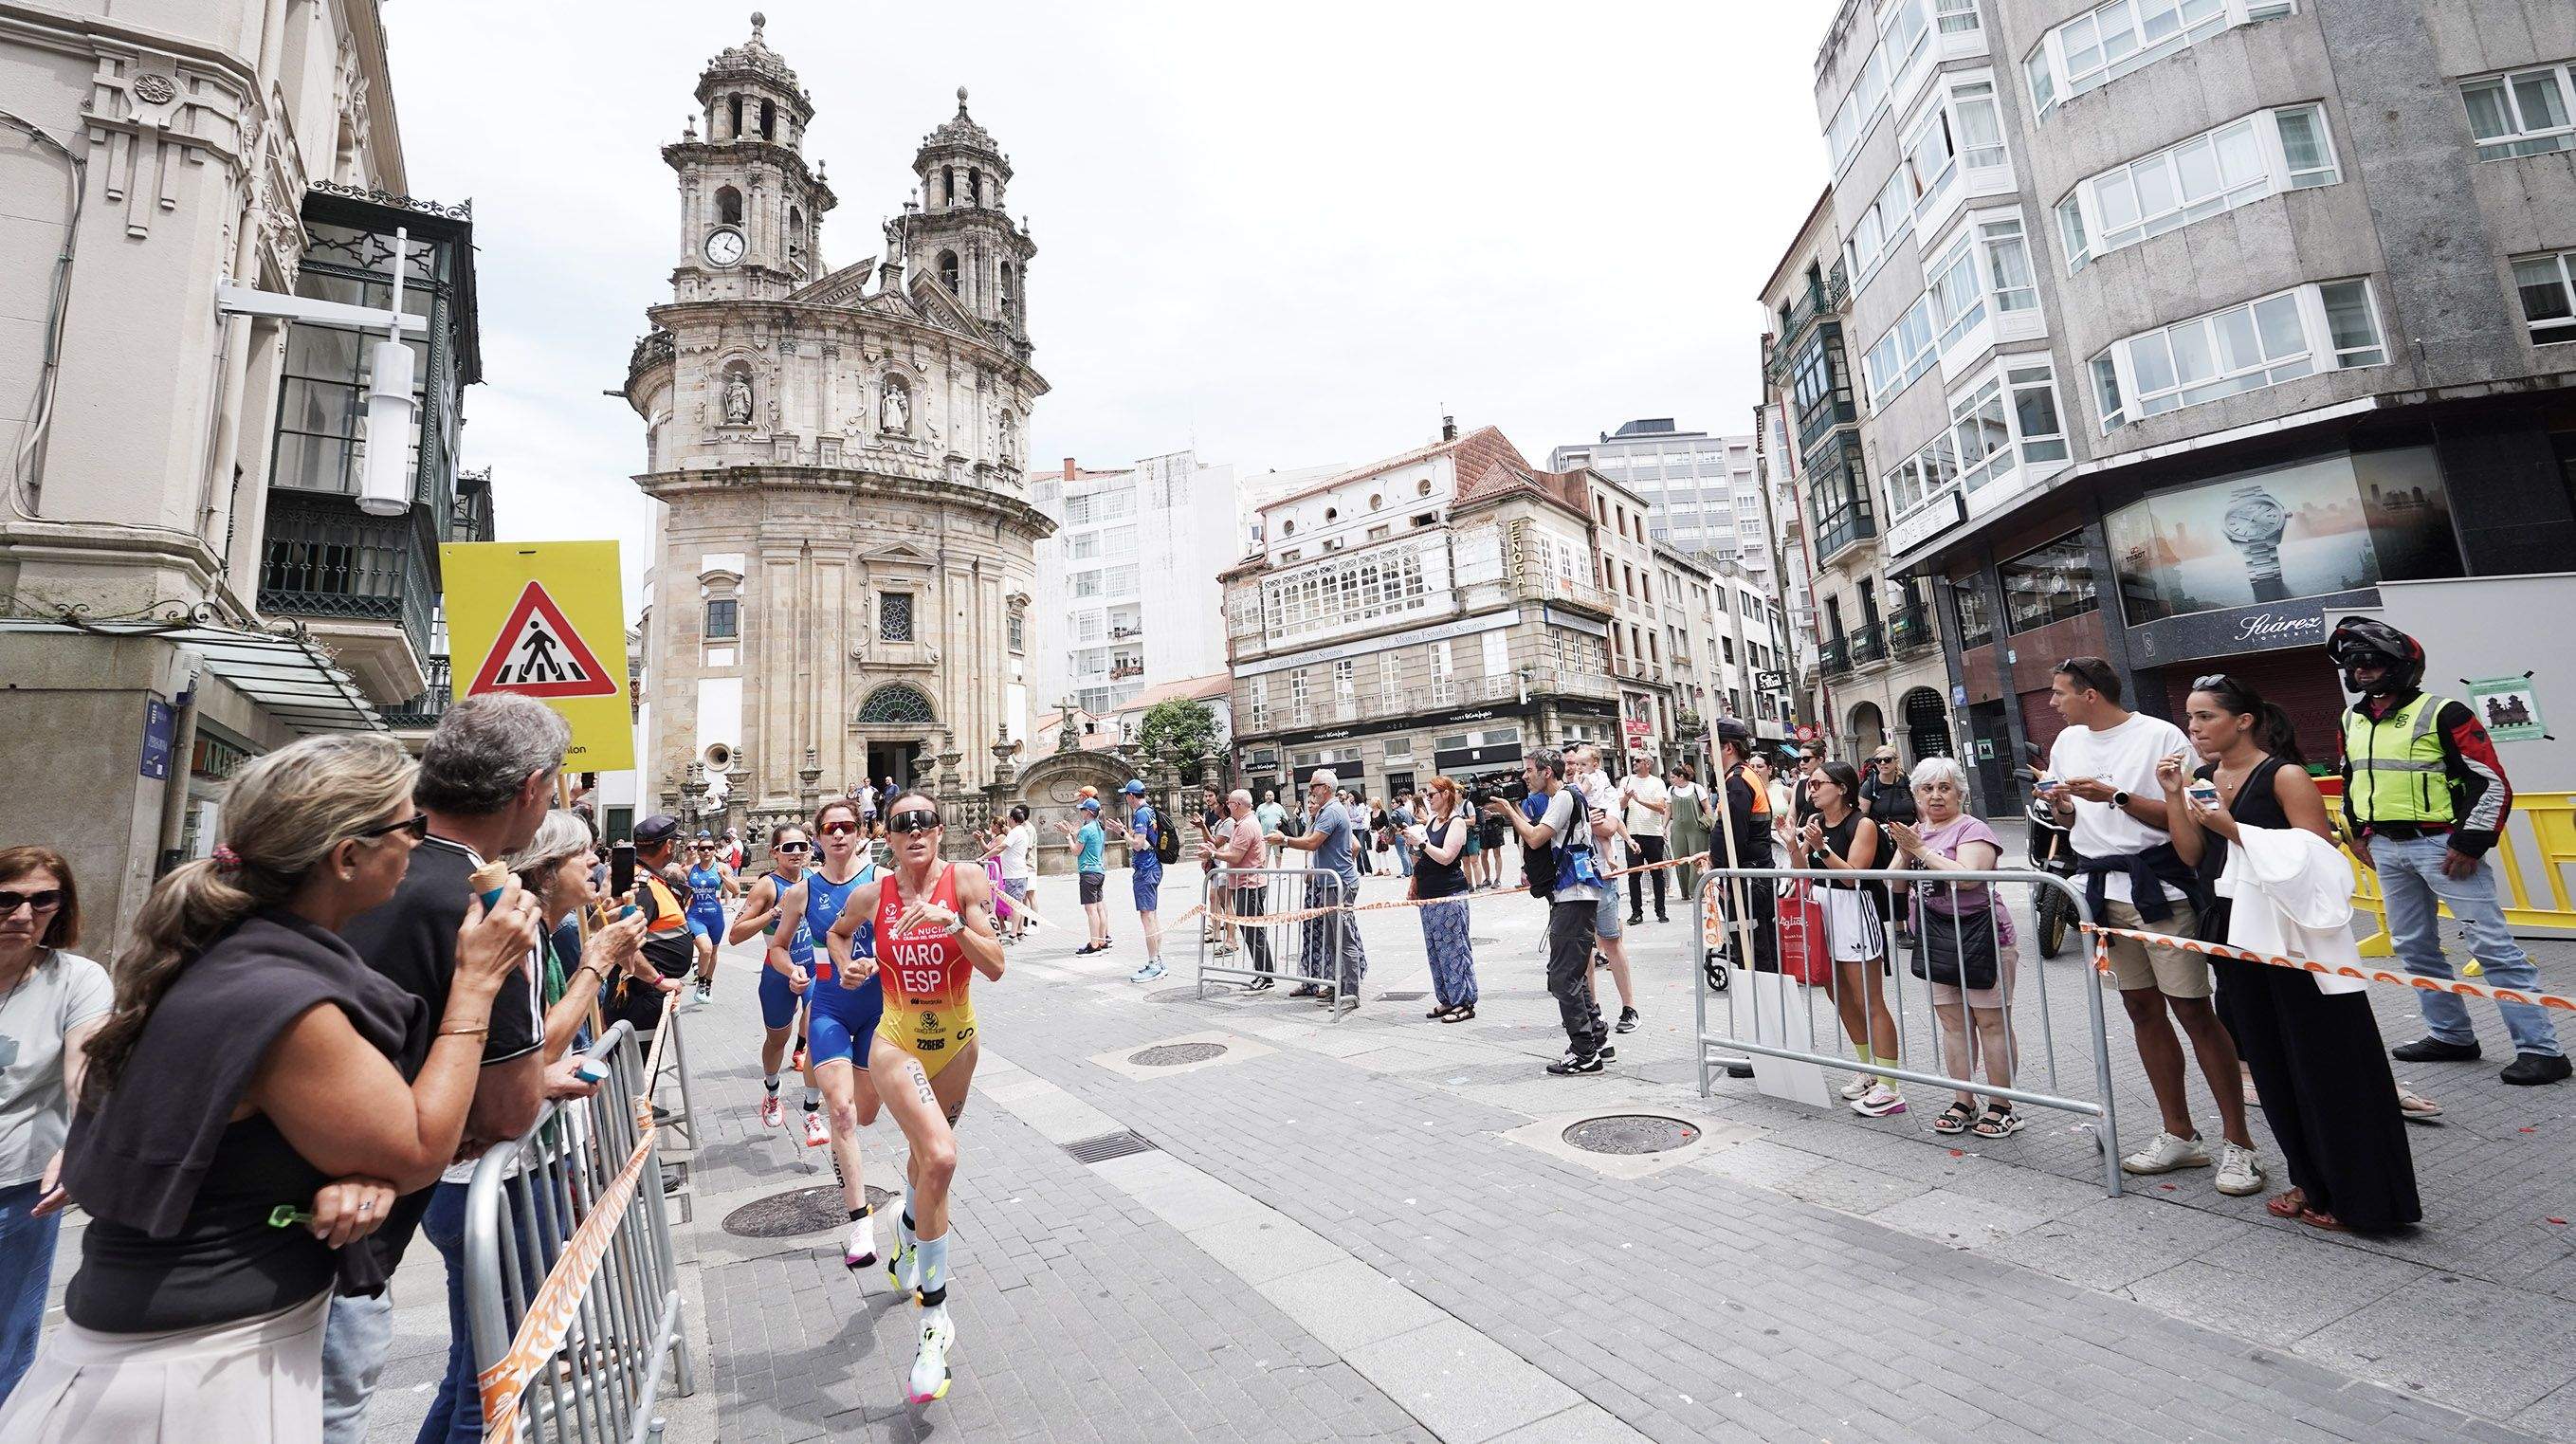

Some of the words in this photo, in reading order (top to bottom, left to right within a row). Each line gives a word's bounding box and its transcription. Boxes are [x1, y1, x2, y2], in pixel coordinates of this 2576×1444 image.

[1509, 520, 1526, 597] FENOGAL
[1394, 633, 1420, 646] Alianza
[1422, 626, 1454, 640] Española
[1456, 621, 1487, 634] Seguros
[2235, 613, 2322, 640] Suárez
[1269, 659, 1290, 668] Alianza
[1290, 652, 1319, 666] Española
[1319, 649, 1343, 660] Seguros
[892, 942, 944, 966] VARO
[903, 969, 941, 993] ESP
